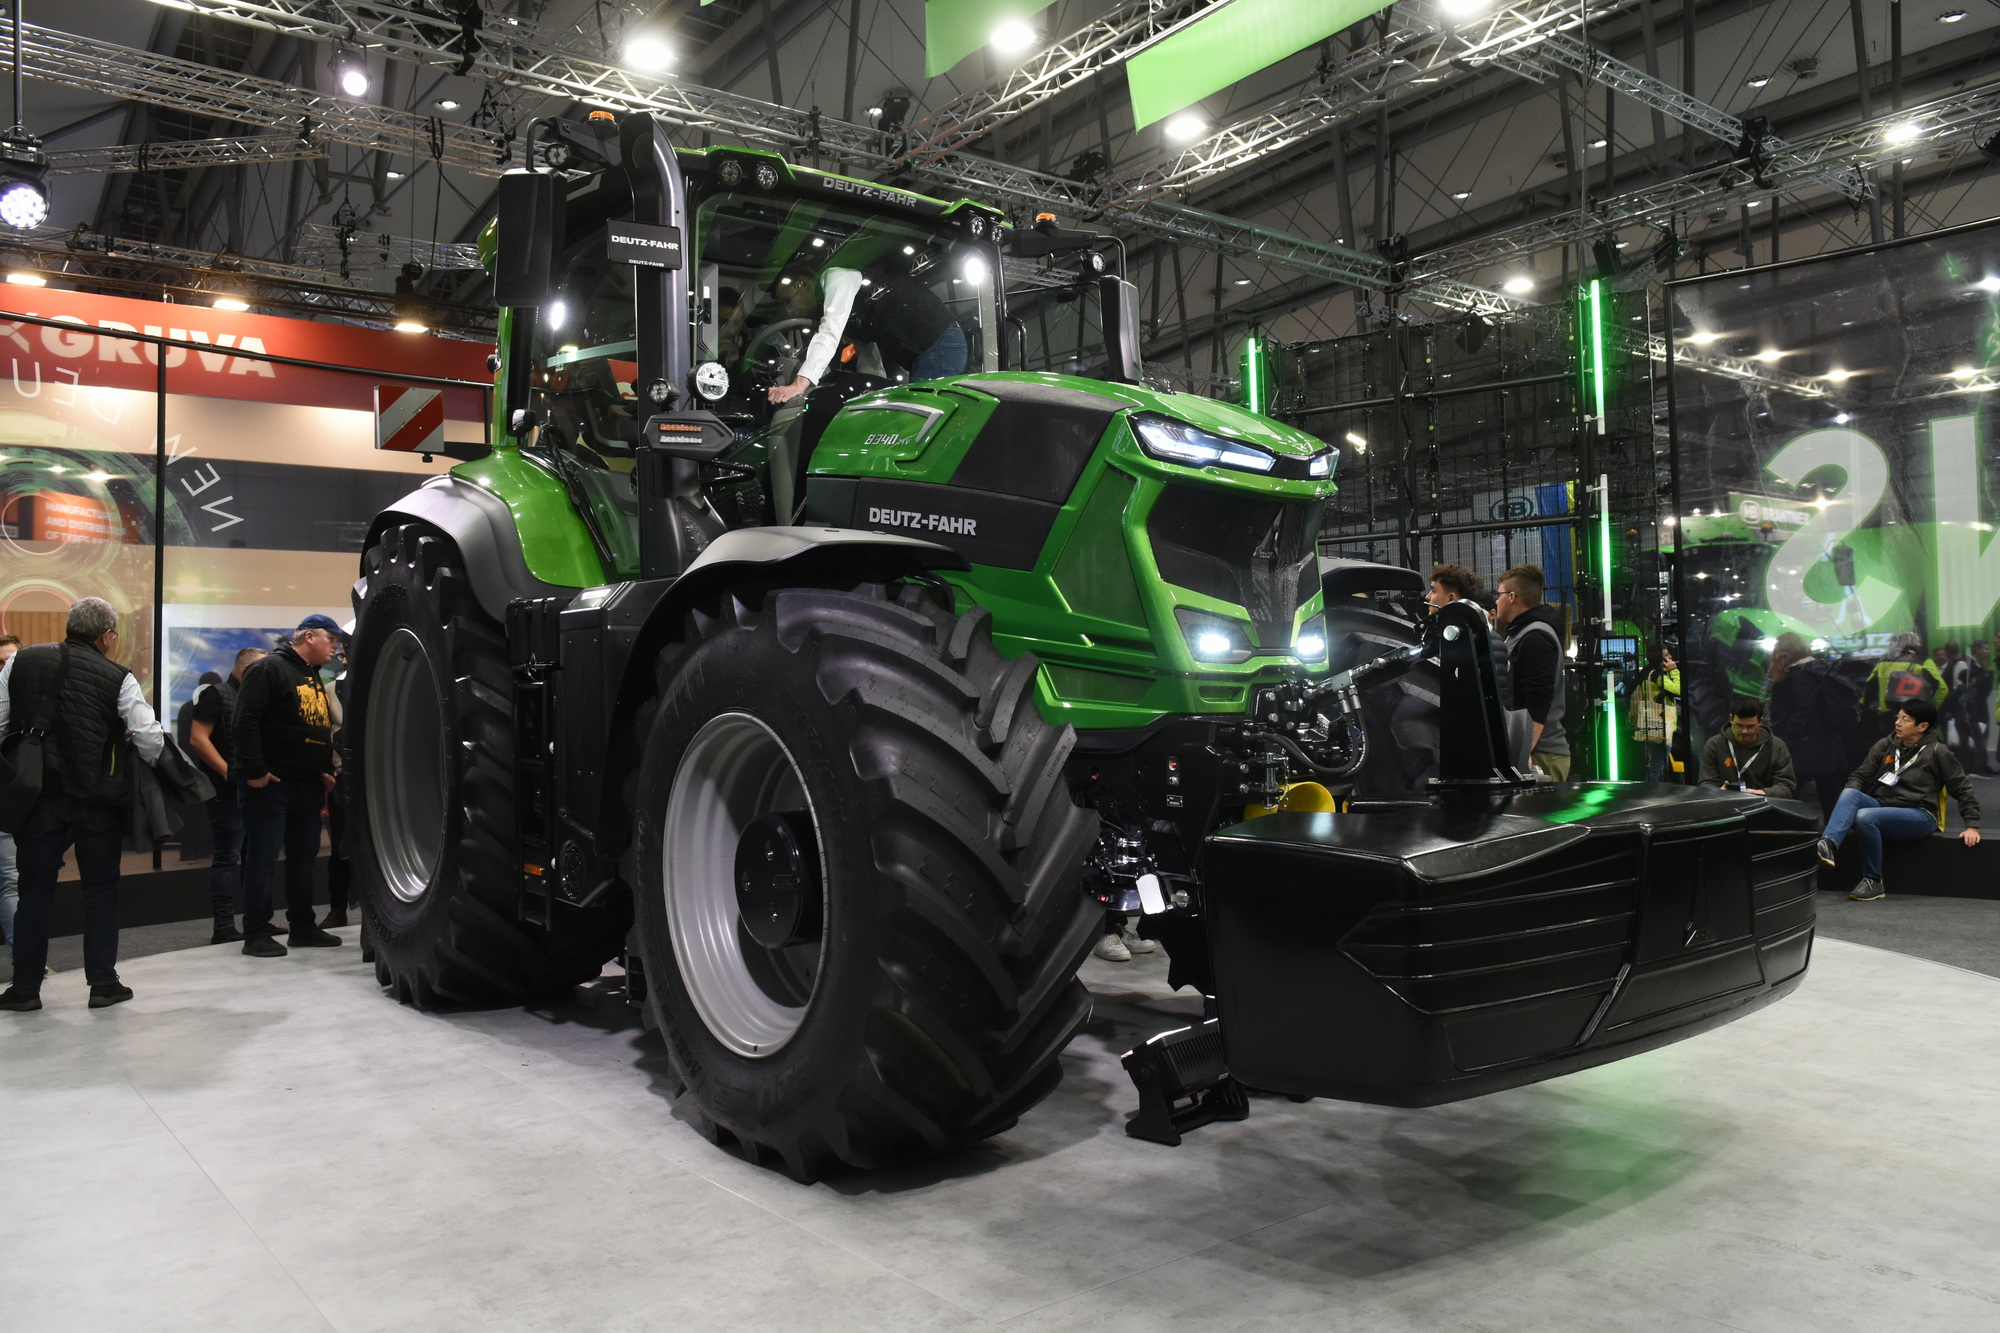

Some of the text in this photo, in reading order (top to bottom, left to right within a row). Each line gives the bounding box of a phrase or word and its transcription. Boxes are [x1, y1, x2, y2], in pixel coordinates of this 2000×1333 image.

[822, 176, 917, 208] DEUTZ-FAHR
[611, 234, 679, 251] DEUTZ-FAHR
[628, 259, 665, 268] DEUTZ-FAHR
[40, 314, 276, 379] GRUVA
[864, 433, 900, 445] 8340
[45, 516, 67, 528] AND
[868, 507, 977, 536] DEUTZ-FAHR
[45, 531, 59, 540] OF
[1823, 632, 1894, 648] EUTZ
